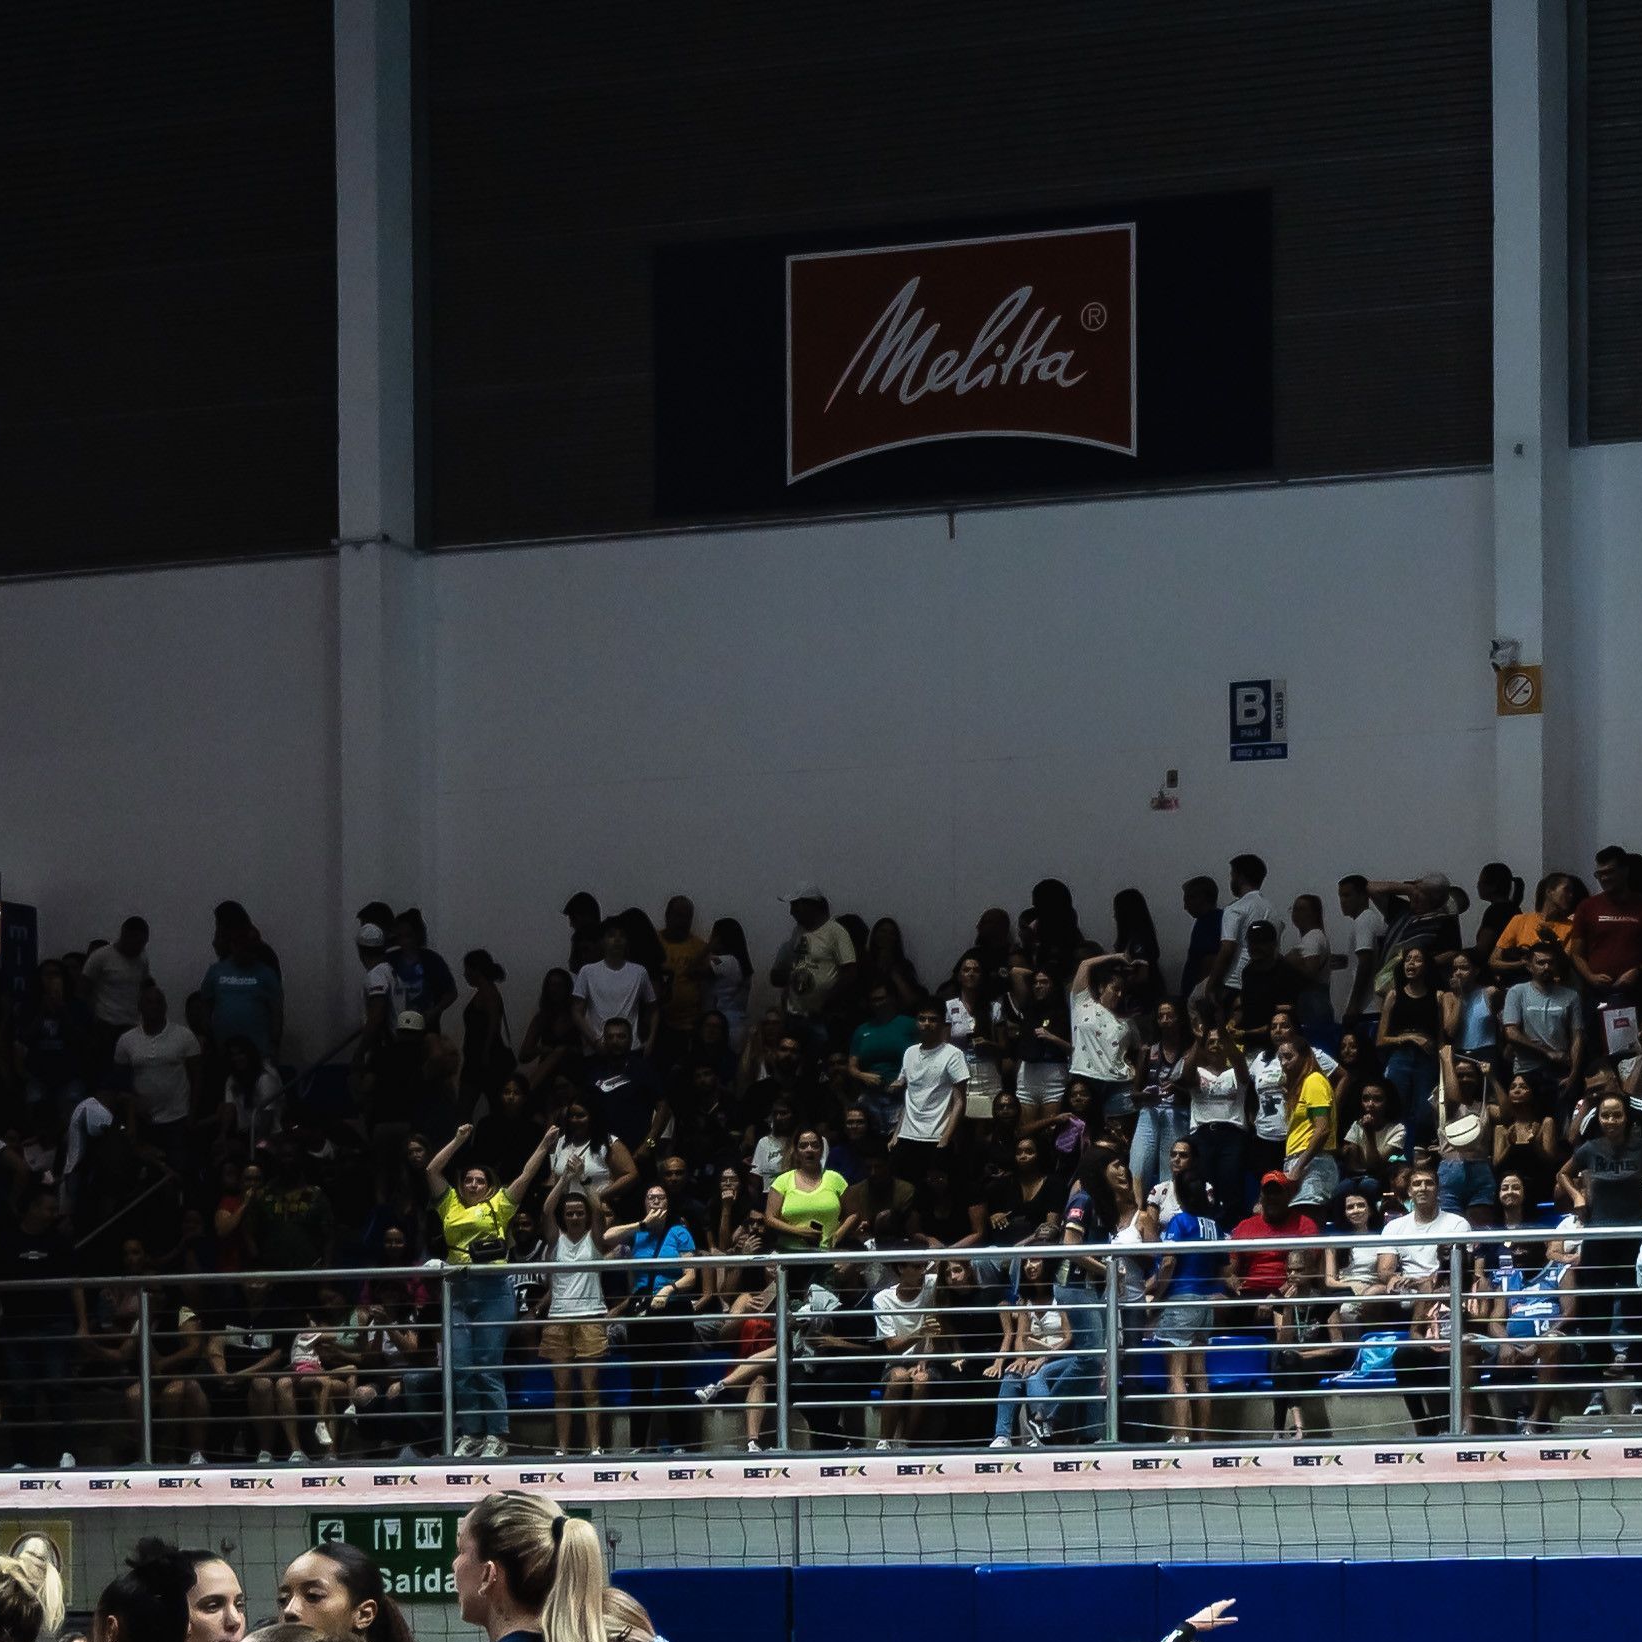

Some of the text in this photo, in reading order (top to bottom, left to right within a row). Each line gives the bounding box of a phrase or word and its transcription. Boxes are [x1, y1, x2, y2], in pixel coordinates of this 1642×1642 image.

[824, 275, 1088, 415] Melitta
[1236, 686, 1266, 726] B
[1374, 1452, 1425, 1465] BET7K
[1539, 1448, 1592, 1461] BET7K
[974, 1461, 1023, 1474] BET7K
[1132, 1458, 1182, 1471] BET7K
[668, 1468, 714, 1481] BET7K
[819, 1465, 867, 1478] BET7K
[19, 1479, 62, 1491] BET7K
[158, 1477, 203, 1489] BET7K
[373, 1474, 418, 1487] BET7K
[519, 1472, 564, 1485] BET7K
